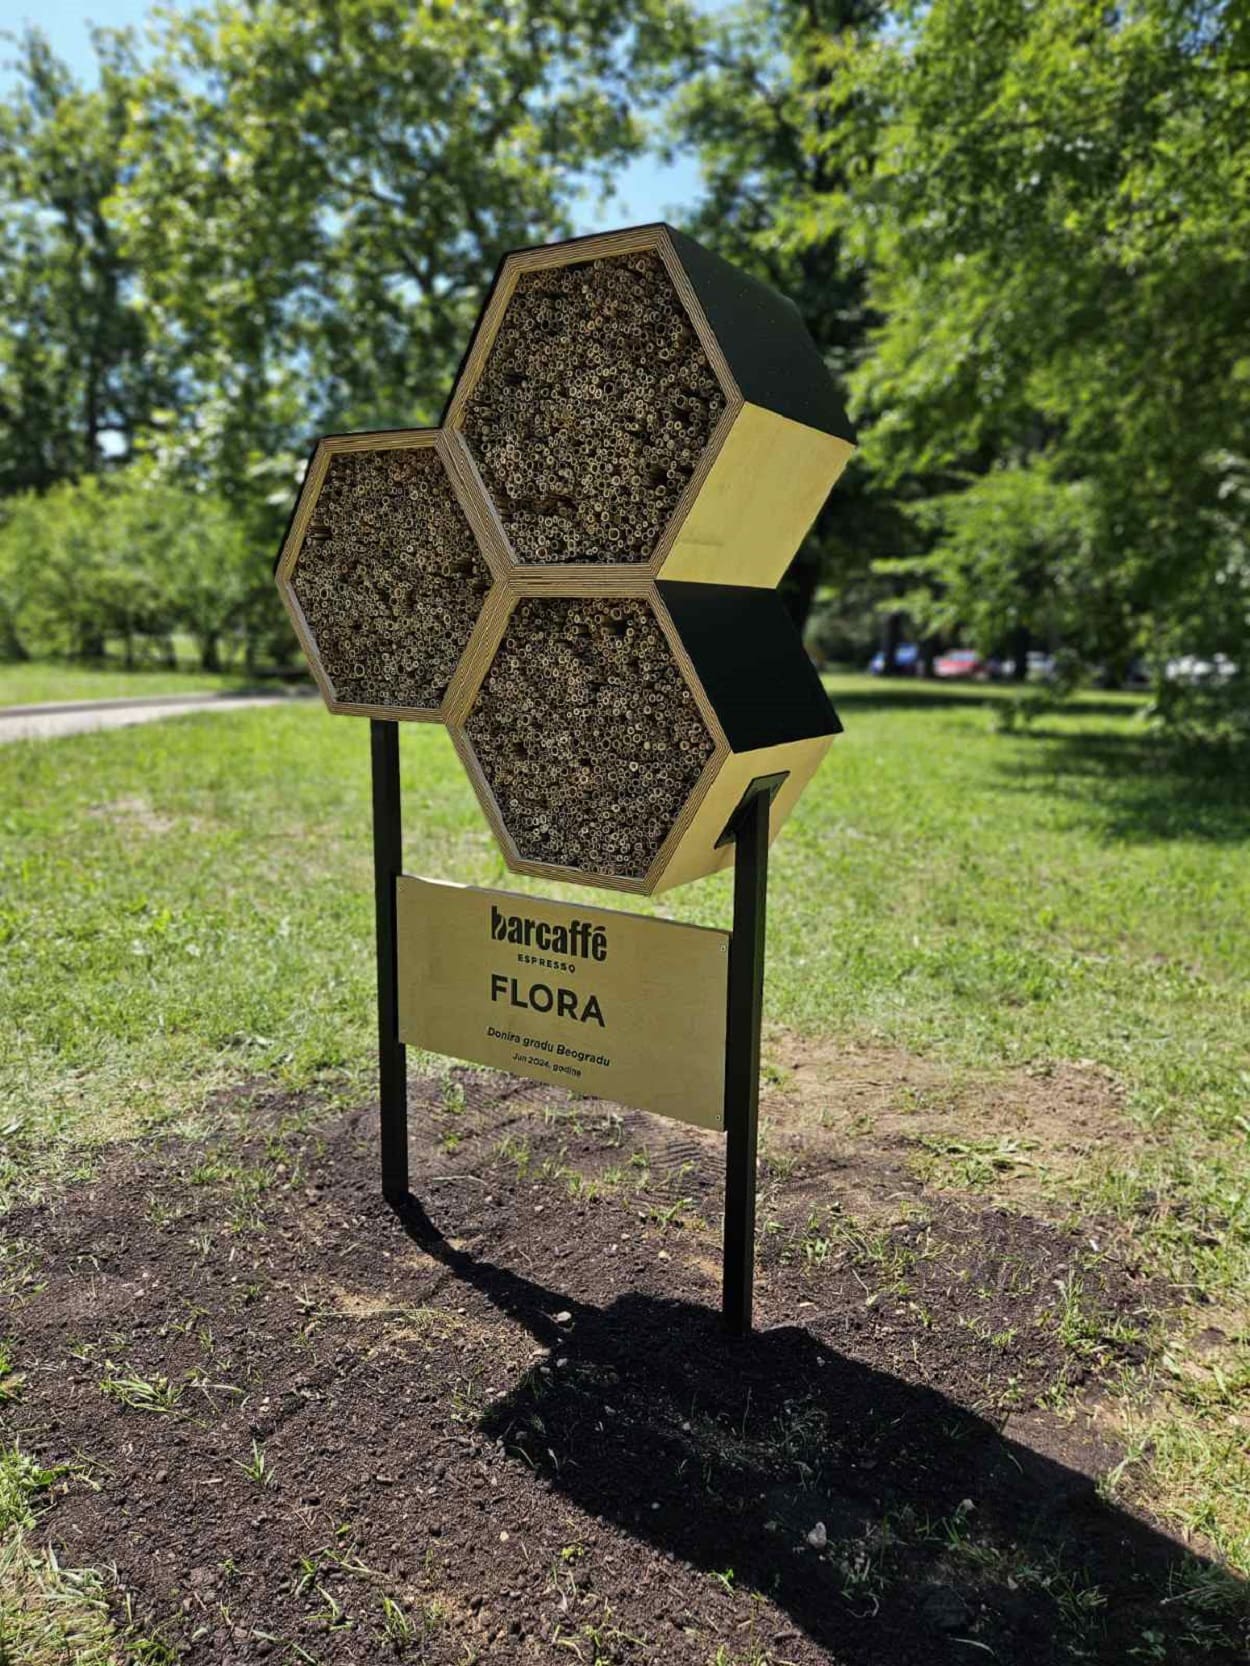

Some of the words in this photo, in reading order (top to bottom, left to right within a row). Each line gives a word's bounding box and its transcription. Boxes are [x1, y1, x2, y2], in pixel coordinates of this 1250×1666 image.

[491, 905, 607, 961] barcaffé
[517, 953, 576, 973] ESPRESSO
[491, 973, 605, 1028] FLORA
[487, 1026, 520, 1043] Donira
[523, 1036, 553, 1052] gradu
[556, 1044, 610, 1066] Beogradu
[553, 1063, 582, 1077] godine
